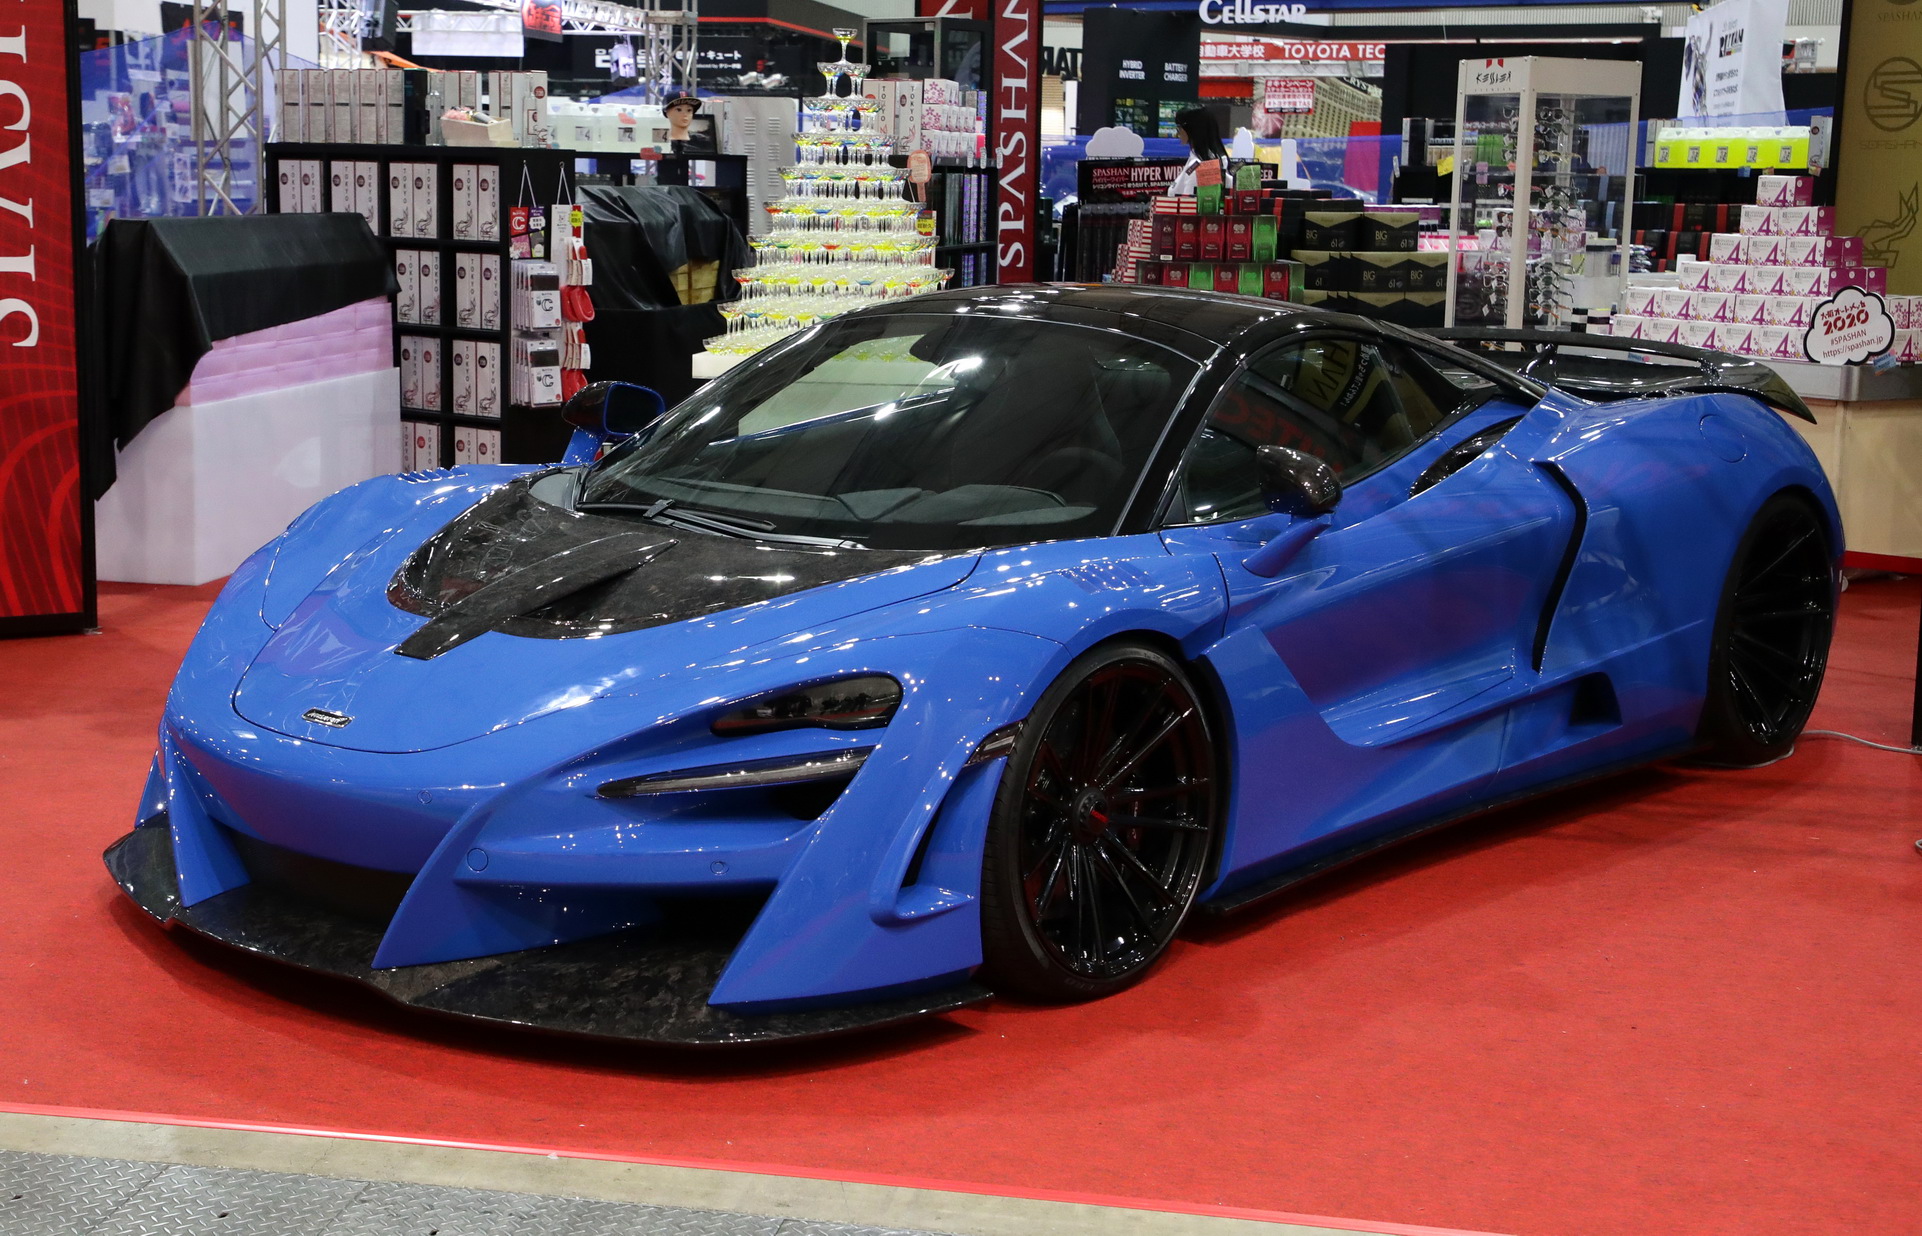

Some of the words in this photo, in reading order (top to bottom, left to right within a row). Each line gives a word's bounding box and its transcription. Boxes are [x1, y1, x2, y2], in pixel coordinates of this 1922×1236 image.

[1283, 44, 1351, 58] TOYOTA
[1118, 69, 1146, 80] INVERTER
[1122, 59, 1143, 70] HYBRID
[1164, 62, 1188, 72] BATTERY
[1163, 72, 1188, 82] CHARGER
[1092, 167, 1130, 177] SPASHAN
[1131, 166, 1161, 182] HYPER
[1774, 181, 1788, 206] 4
[1305, 229, 1318, 239] BIG
[1758, 211, 1772, 236] 4
[1796, 211, 1810, 236] 4
[1330, 239, 1338, 248] 61
[1375, 230, 1388, 241] BIG
[1400, 239, 1408, 249] 61
[1726, 239, 1741, 264] 4
[1764, 240, 1779, 265] 4
[1802, 240, 1817, 266] 4
[1315, 277, 1323, 286] 61
[1363, 270, 1376, 281] BIG
[1388, 279, 1396, 289] 61
[1410, 270, 1423, 280] BIG
[1435, 278, 1443, 287] 61
[1695, 267, 1710, 292] 4
[1732, 270, 1747, 294] 4
[1770, 271, 1784, 295] 4
[1807, 272, 1822, 296] 4
[1641, 293, 1655, 317] 4
[1676, 296, 1691, 320] 4
[1713, 297, 1728, 322] 4
[1751, 299, 1766, 325] 4
[1788, 301, 1804, 327] 4
[1823, 309, 1869, 335] 2020
[1666, 324, 1680, 344] 4
[1701, 327, 1716, 350] 4
[1738, 329, 1753, 354] 4
[1774, 331, 1790, 357] 4
[1830, 329, 1867, 346] #SPASHAN
[1822, 335, 1884, 358] https://spashan.jp
[1901, 334, 1914, 361] 4
